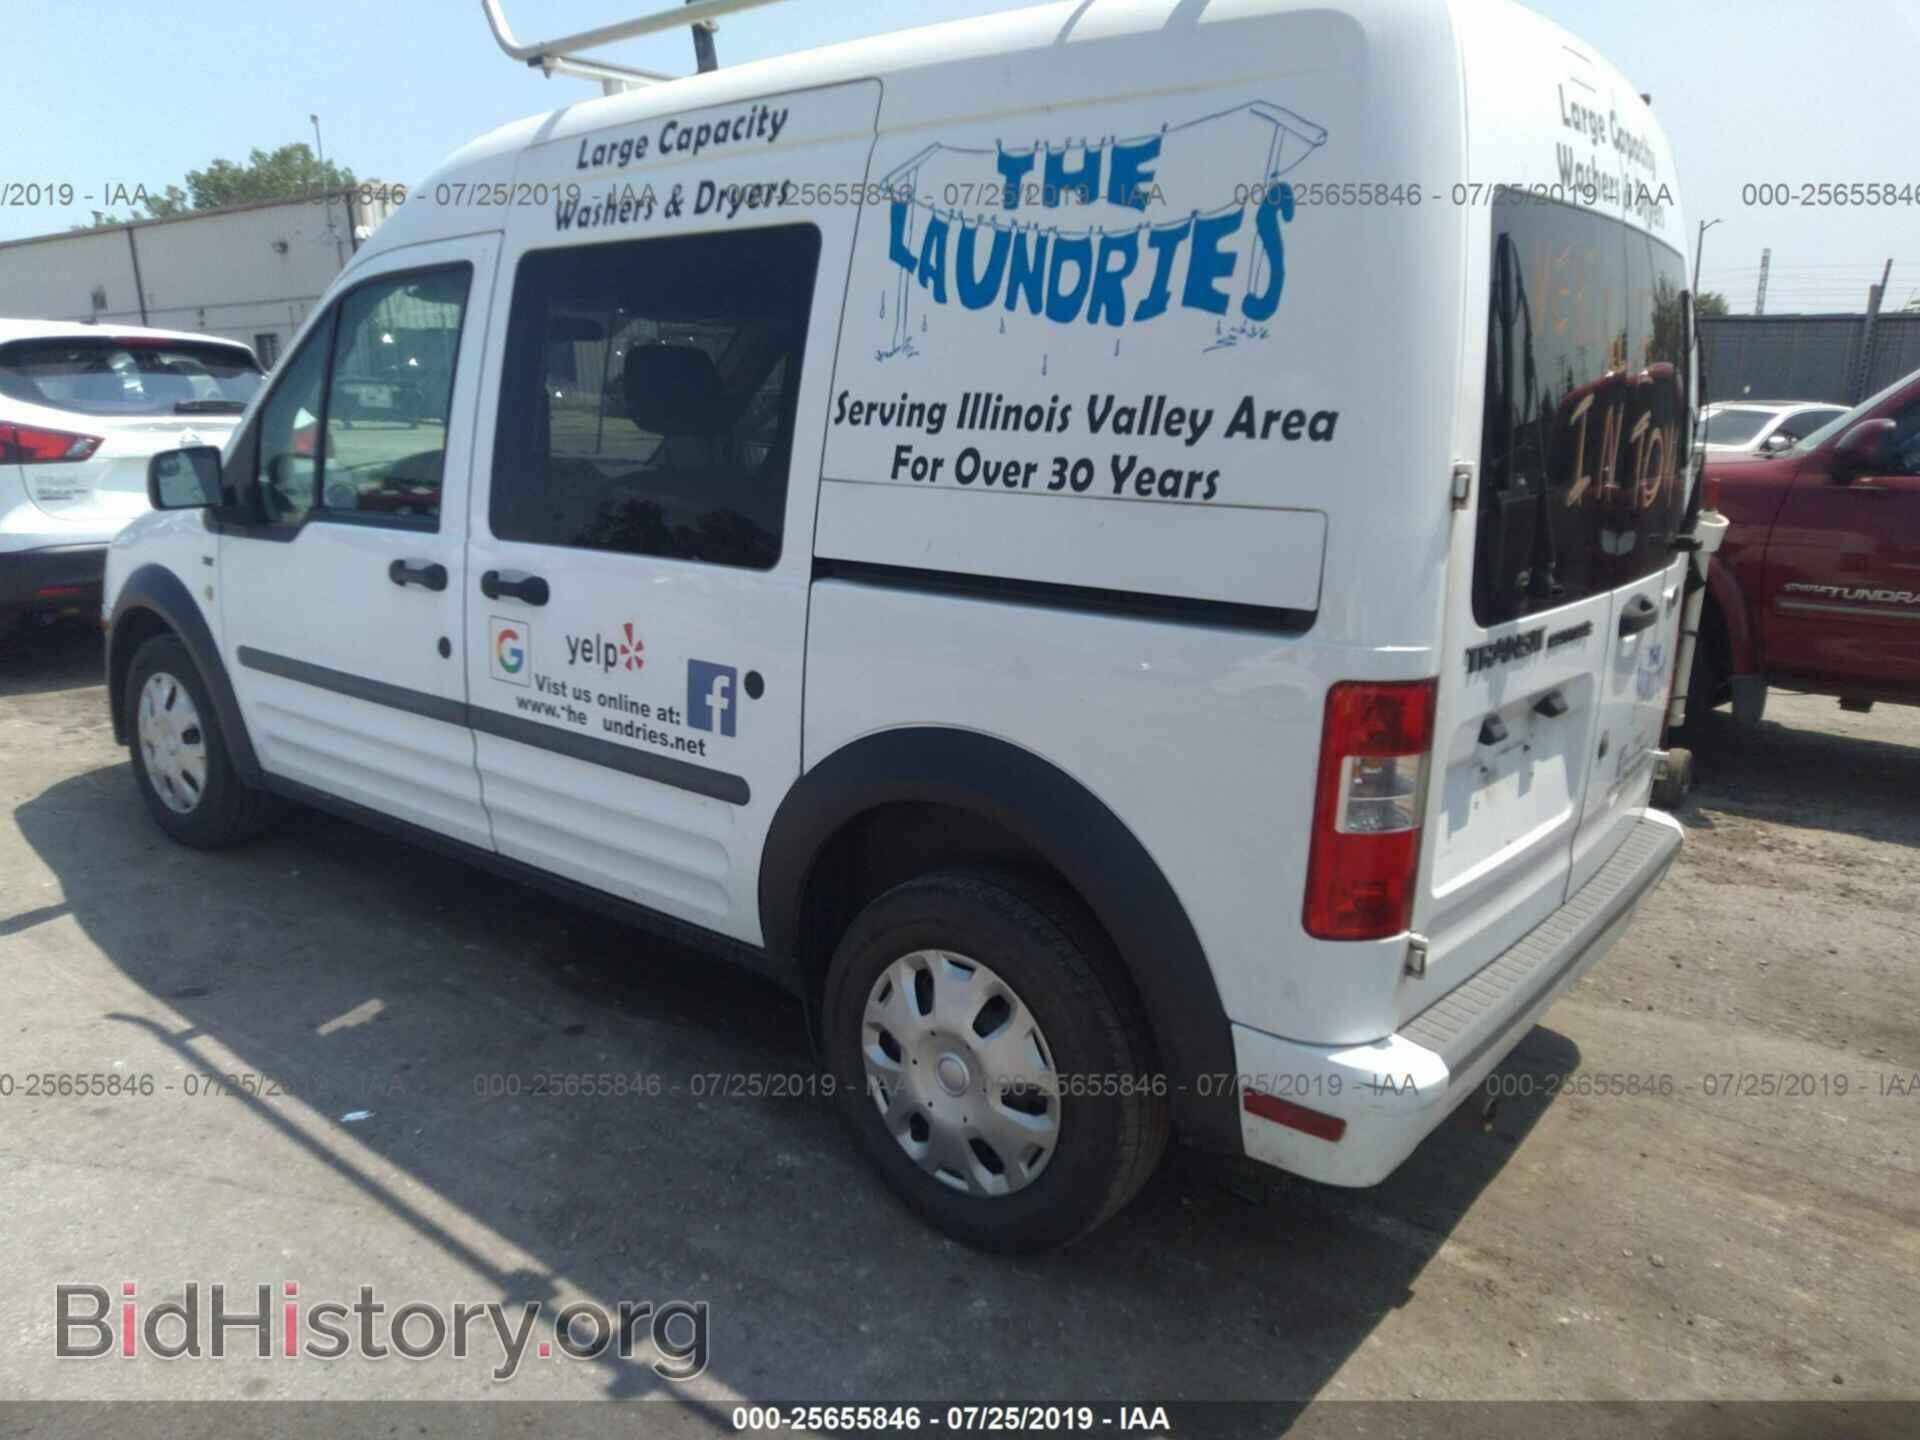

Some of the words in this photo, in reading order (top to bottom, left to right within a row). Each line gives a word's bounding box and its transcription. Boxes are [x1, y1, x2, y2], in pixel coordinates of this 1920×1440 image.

[576, 139, 648, 170] Large
[659, 105, 788, 156] Capacity
[996, 135, 1162, 212] THE
[556, 193, 654, 231] Washers
[664, 183, 683, 218] &
[693, 178, 790, 219] Dryers
[889, 181, 1295, 326] LAUNDRIES
[834, 390, 947, 435] Serving
[956, 393, 1072, 433] Illinois
[1086, 394, 1213, 447] Valley
[1224, 396, 1339, 442] Area
[890, 445, 944, 483] For
[954, 447, 1038, 489] Over
[1047, 457, 1095, 492] 30
[1110, 455, 1220, 500] Years
[496, 628, 524, 673] G
[565, 632, 618, 672] yelp
[535, 673, 566, 698] Vist
[572, 686, 591, 704] us
[597, 692, 650, 718] online
[657, 705, 681, 726] at:
